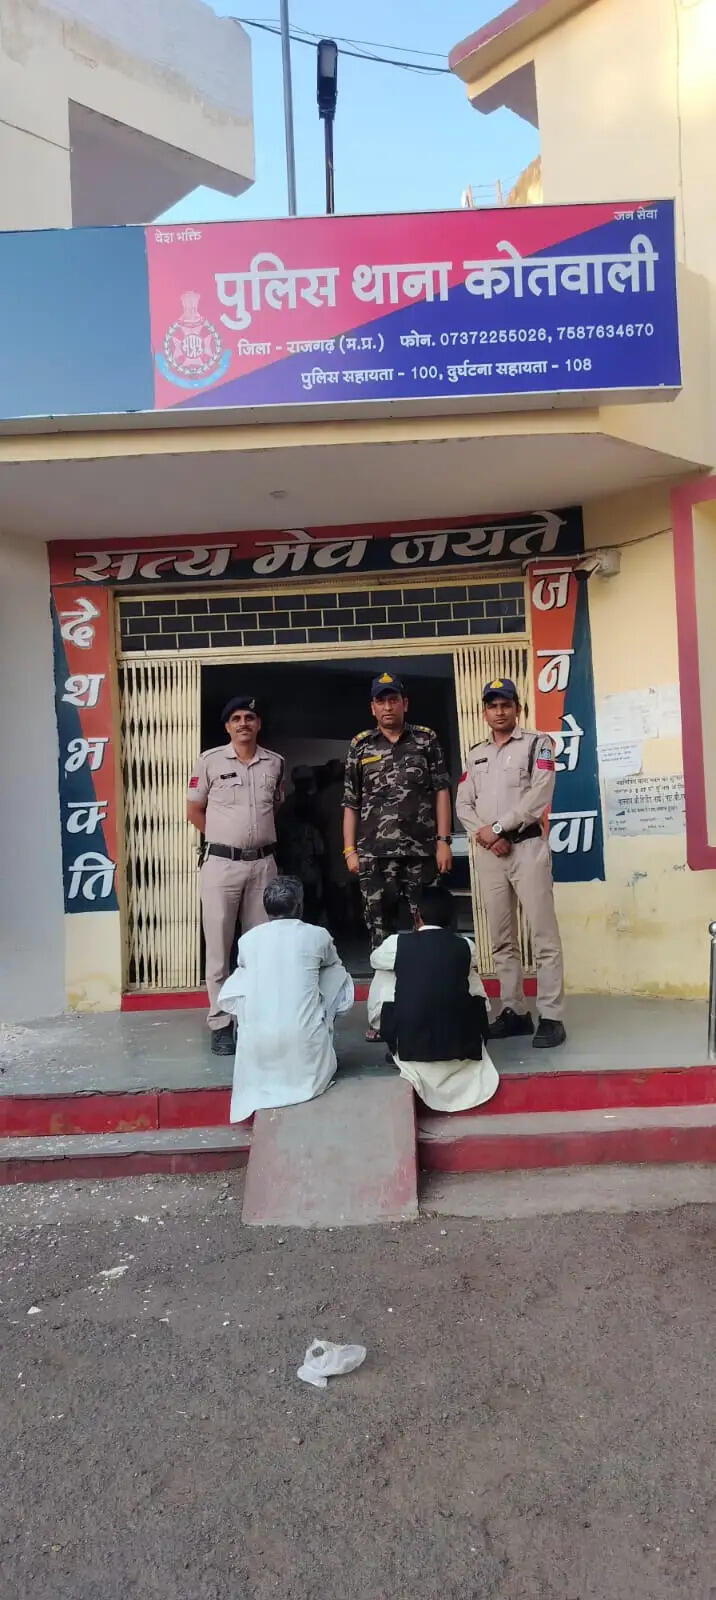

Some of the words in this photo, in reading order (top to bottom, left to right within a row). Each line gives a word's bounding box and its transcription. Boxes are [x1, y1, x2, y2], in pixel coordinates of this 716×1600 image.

[614, 210, 634, 221] जन
[636, 206, 658, 220] सेवा
[214, 252, 340, 331] पुलिस
[351, 261, 453, 305] थाना
[463, 234, 659, 300] कोतवाली
[237, 338, 271, 356] जिला
[286, 338, 335, 354] राजगढ़
[440, 328, 553, 346] 07372255026,
[556, 322, 654, 340] 7587634670
[301, 366, 339, 390] पुलिस
[342, 367, 394, 385] सहायता
[411, 365, 443, 381] 100,
[447, 360, 492, 382] दुर्घटना
[495, 360, 548, 376] सहायता
[565, 358, 592, 372] 108
[74, 543, 238, 582] सत्य
[252, 528, 373, 575] मेव
[389, 510, 567, 564] जयते
